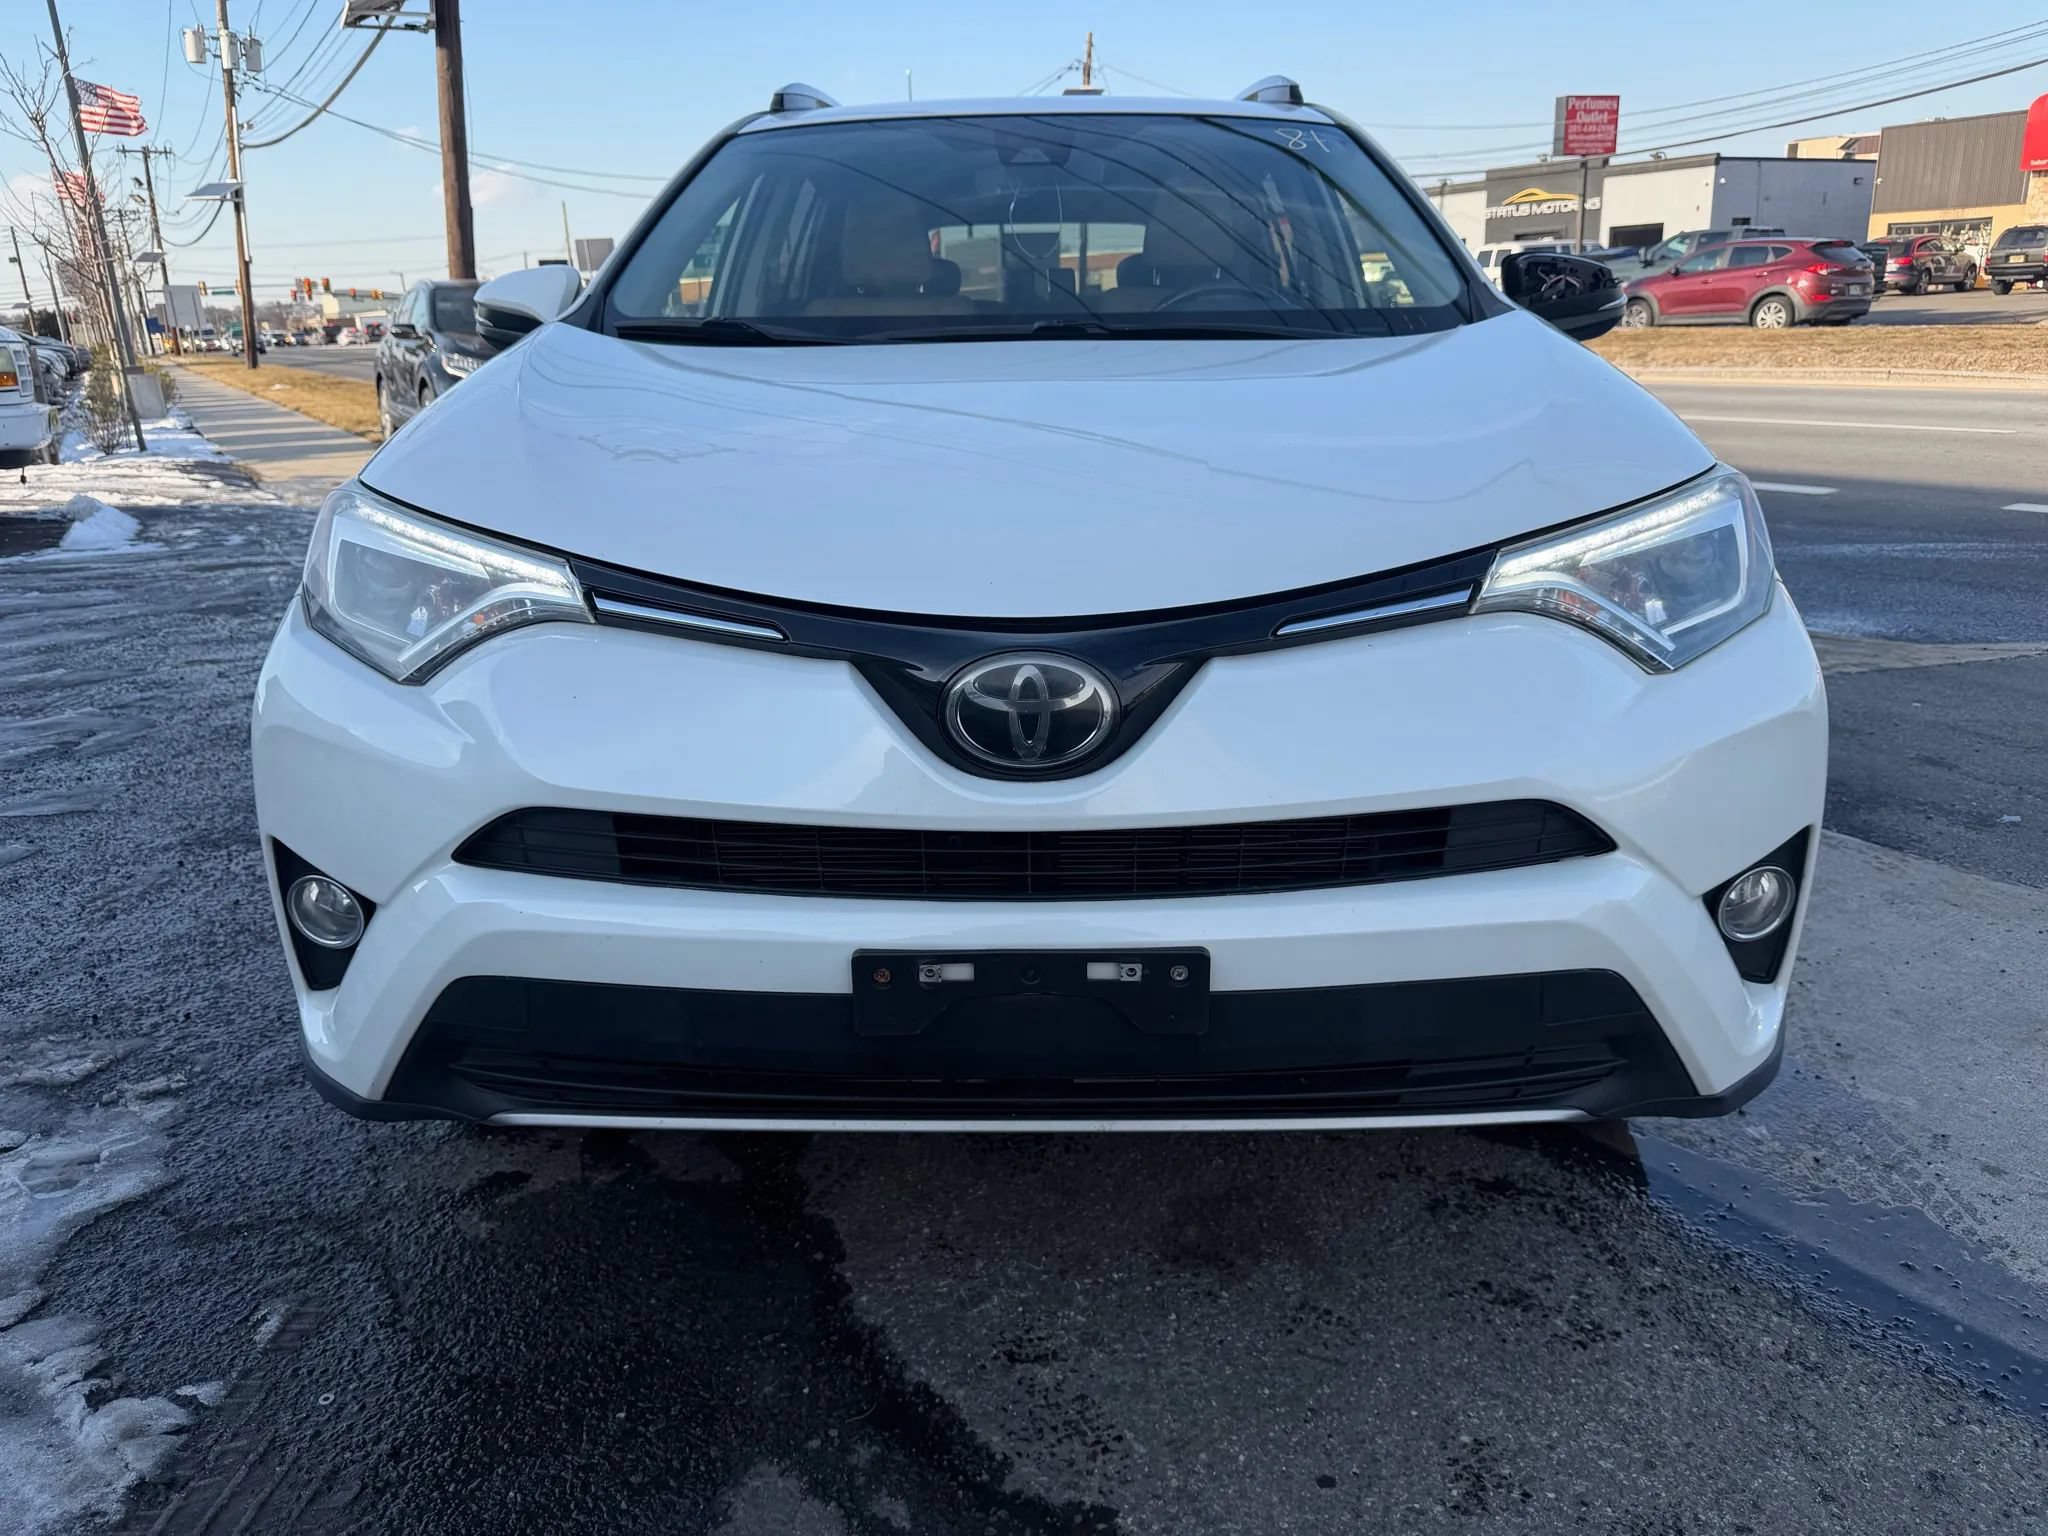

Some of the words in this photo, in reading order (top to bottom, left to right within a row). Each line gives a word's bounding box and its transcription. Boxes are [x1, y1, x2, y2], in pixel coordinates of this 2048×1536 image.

[1567, 97, 1618, 110] Perfumes
[1576, 111, 1609, 123] Outlet
[1484, 202, 1531, 220] STATUS
